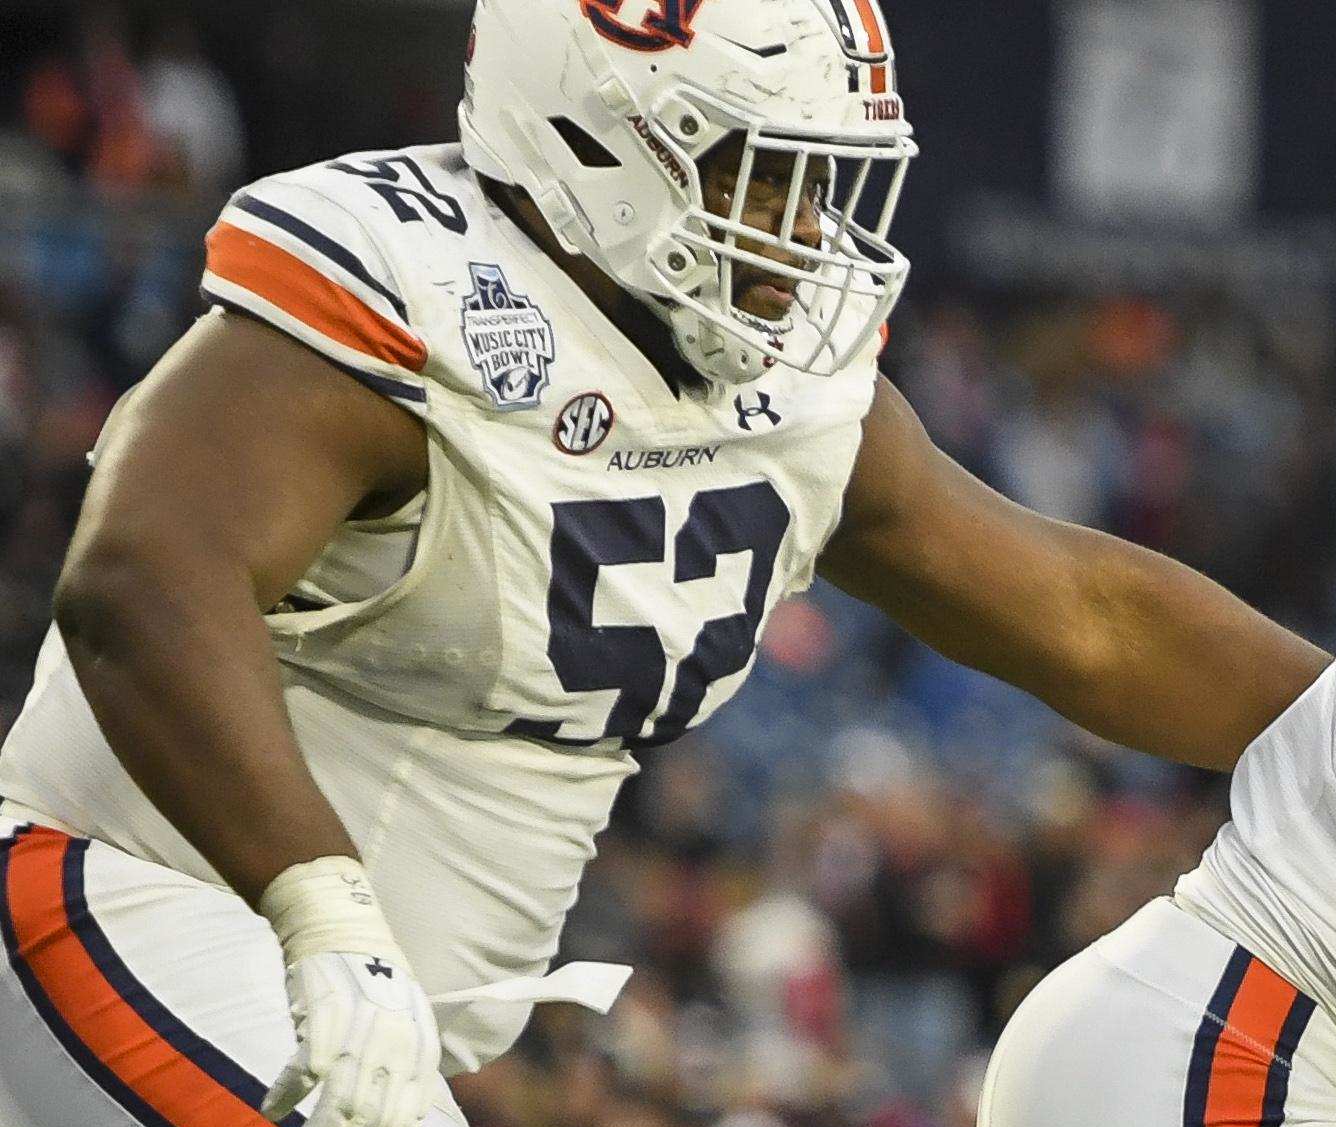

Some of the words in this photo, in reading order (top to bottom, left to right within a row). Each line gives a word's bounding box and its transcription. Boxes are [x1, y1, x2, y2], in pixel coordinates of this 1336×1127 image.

[626, 112, 689, 189] AUBURN
[468, 330, 514, 357] MUSIC
[514, 327, 546, 353] CITY
[491, 350, 535, 371] BOWL
[560, 395, 612, 451] SEC
[607, 446, 720, 471] AUBURN
[501, 479, 790, 751] 52
